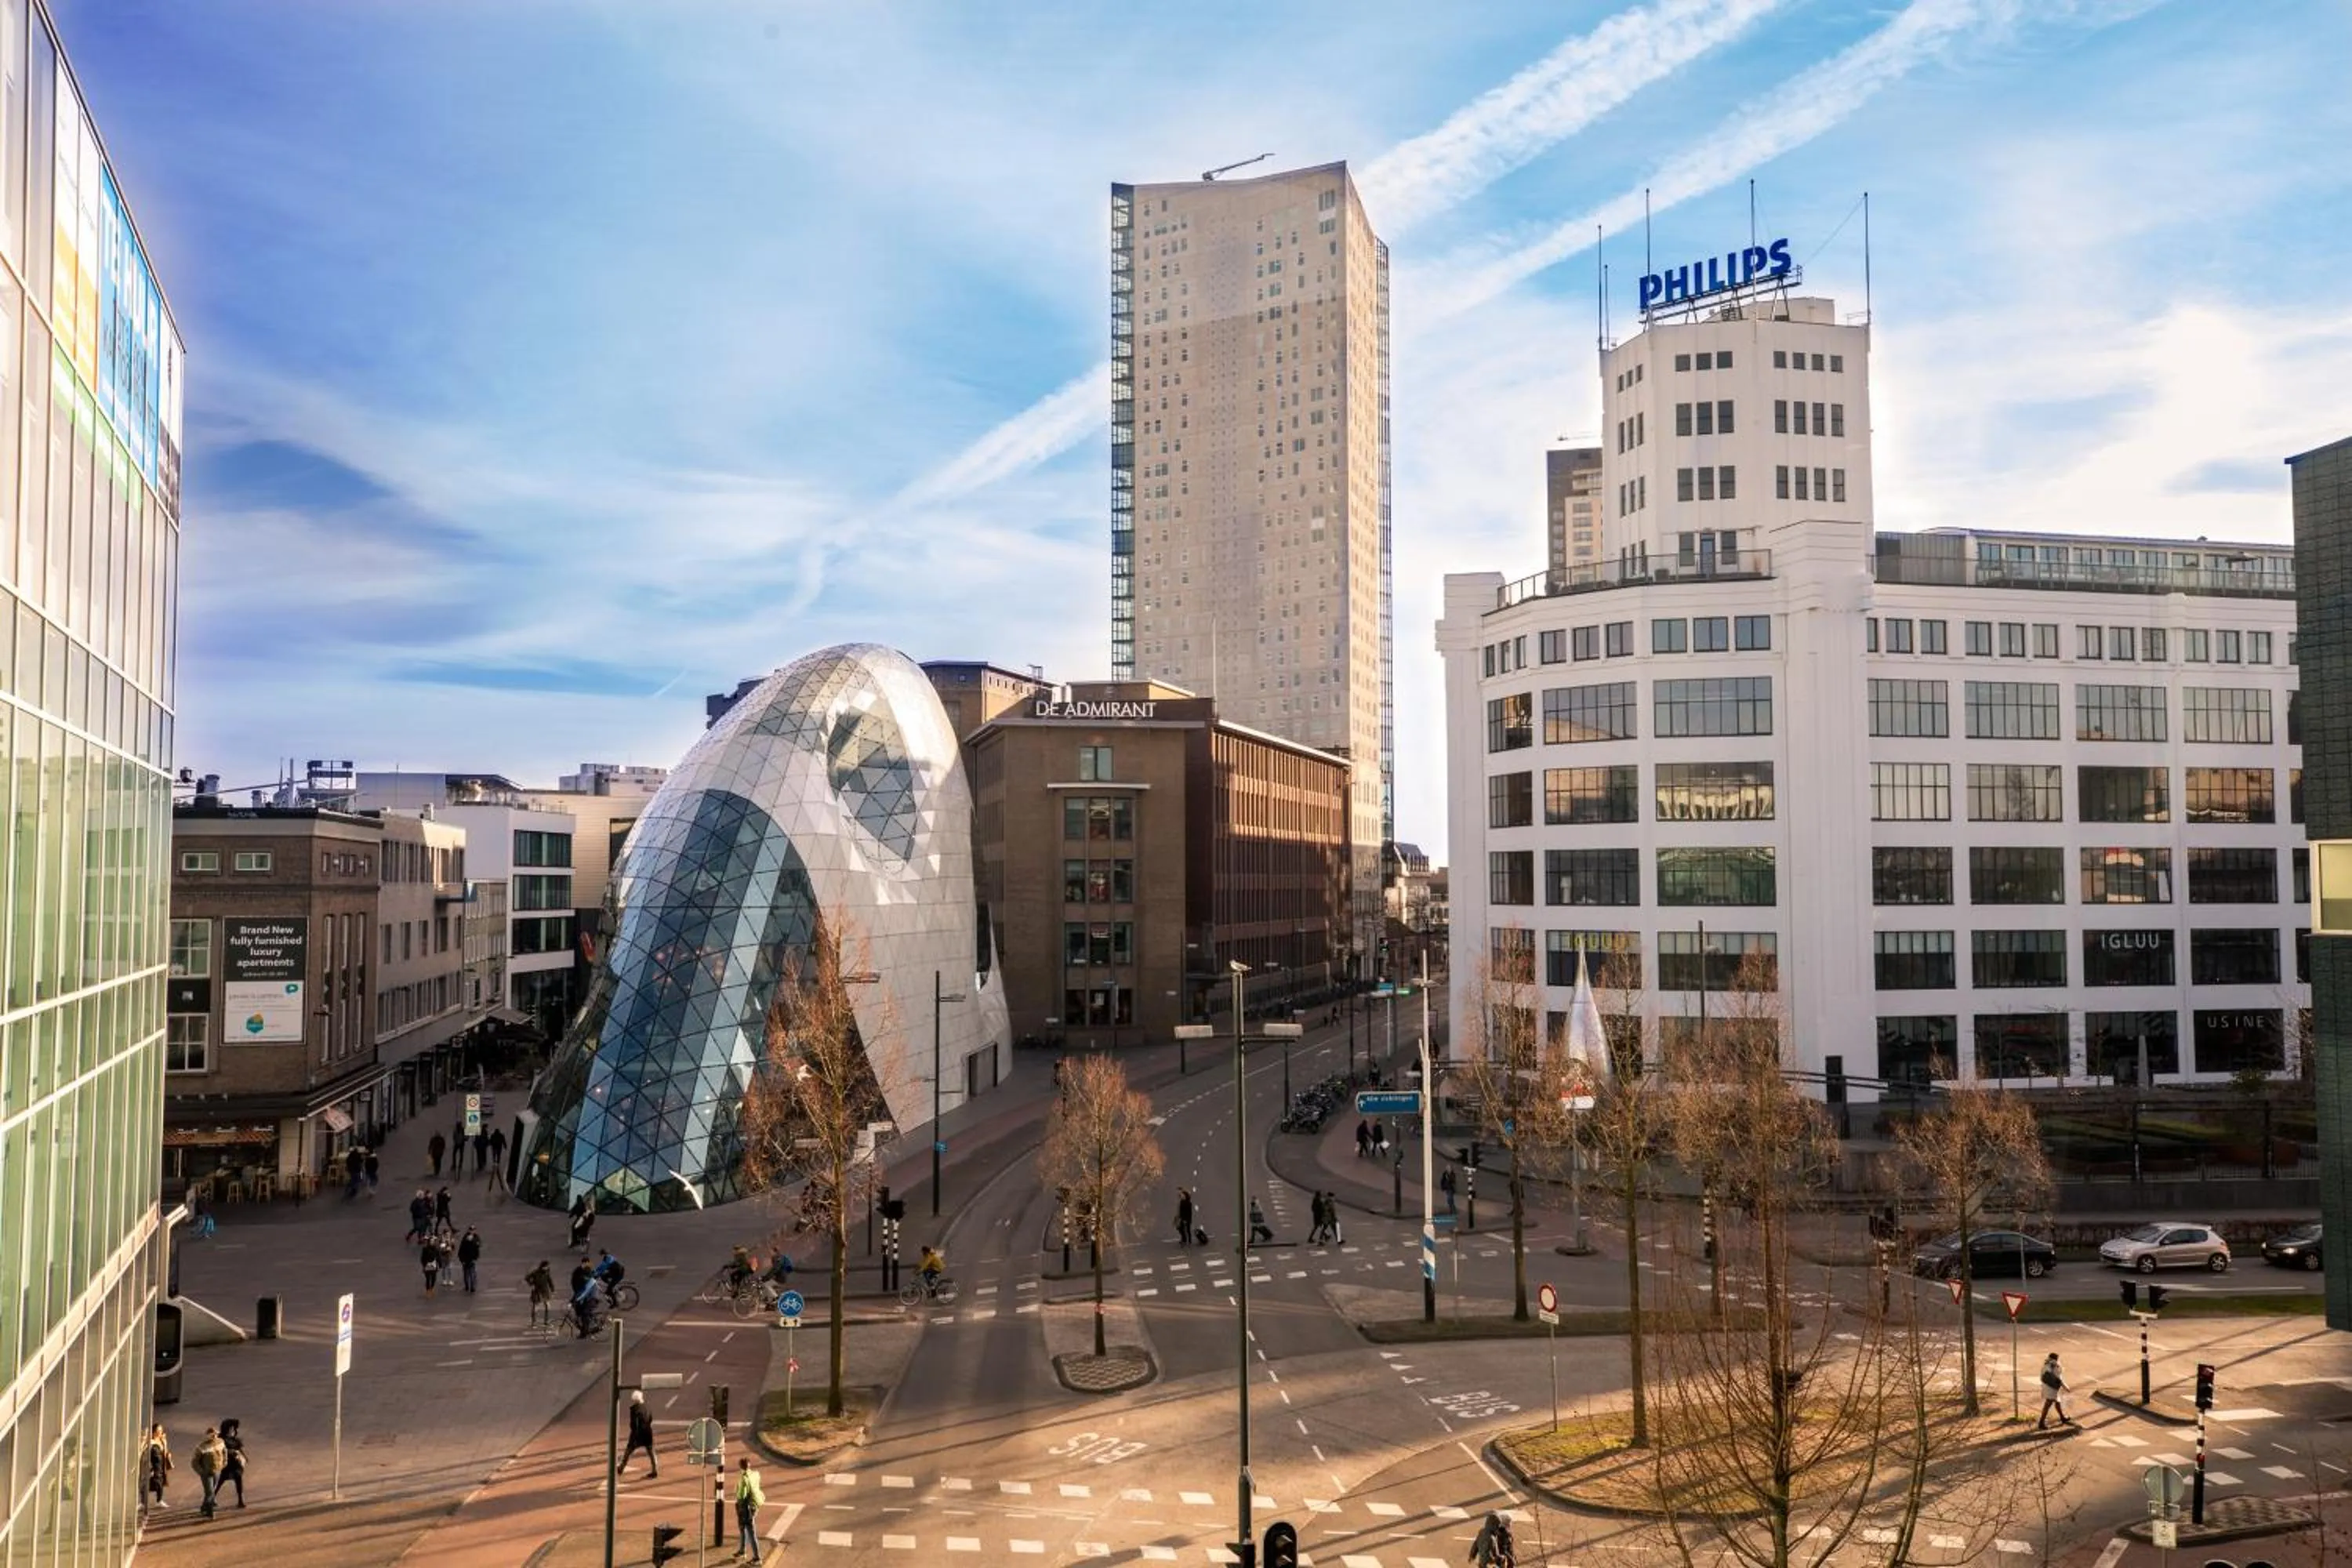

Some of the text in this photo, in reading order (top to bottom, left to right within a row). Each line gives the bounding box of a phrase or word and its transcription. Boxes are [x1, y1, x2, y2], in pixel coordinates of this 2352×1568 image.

[1639, 238, 1791, 310] PHILIPS
[1036, 700, 1156, 718] DE ADMIRANT
[240, 925, 294, 935] Brand New
[230, 935, 303, 946] fully furnished
[2101, 933, 2159, 949] IGLUU
[250, 947, 282, 957] luxury
[237, 958, 295, 968] apartments
[2206, 1015, 2265, 1028] USINE
[1047, 1432, 1149, 1464] BUS
